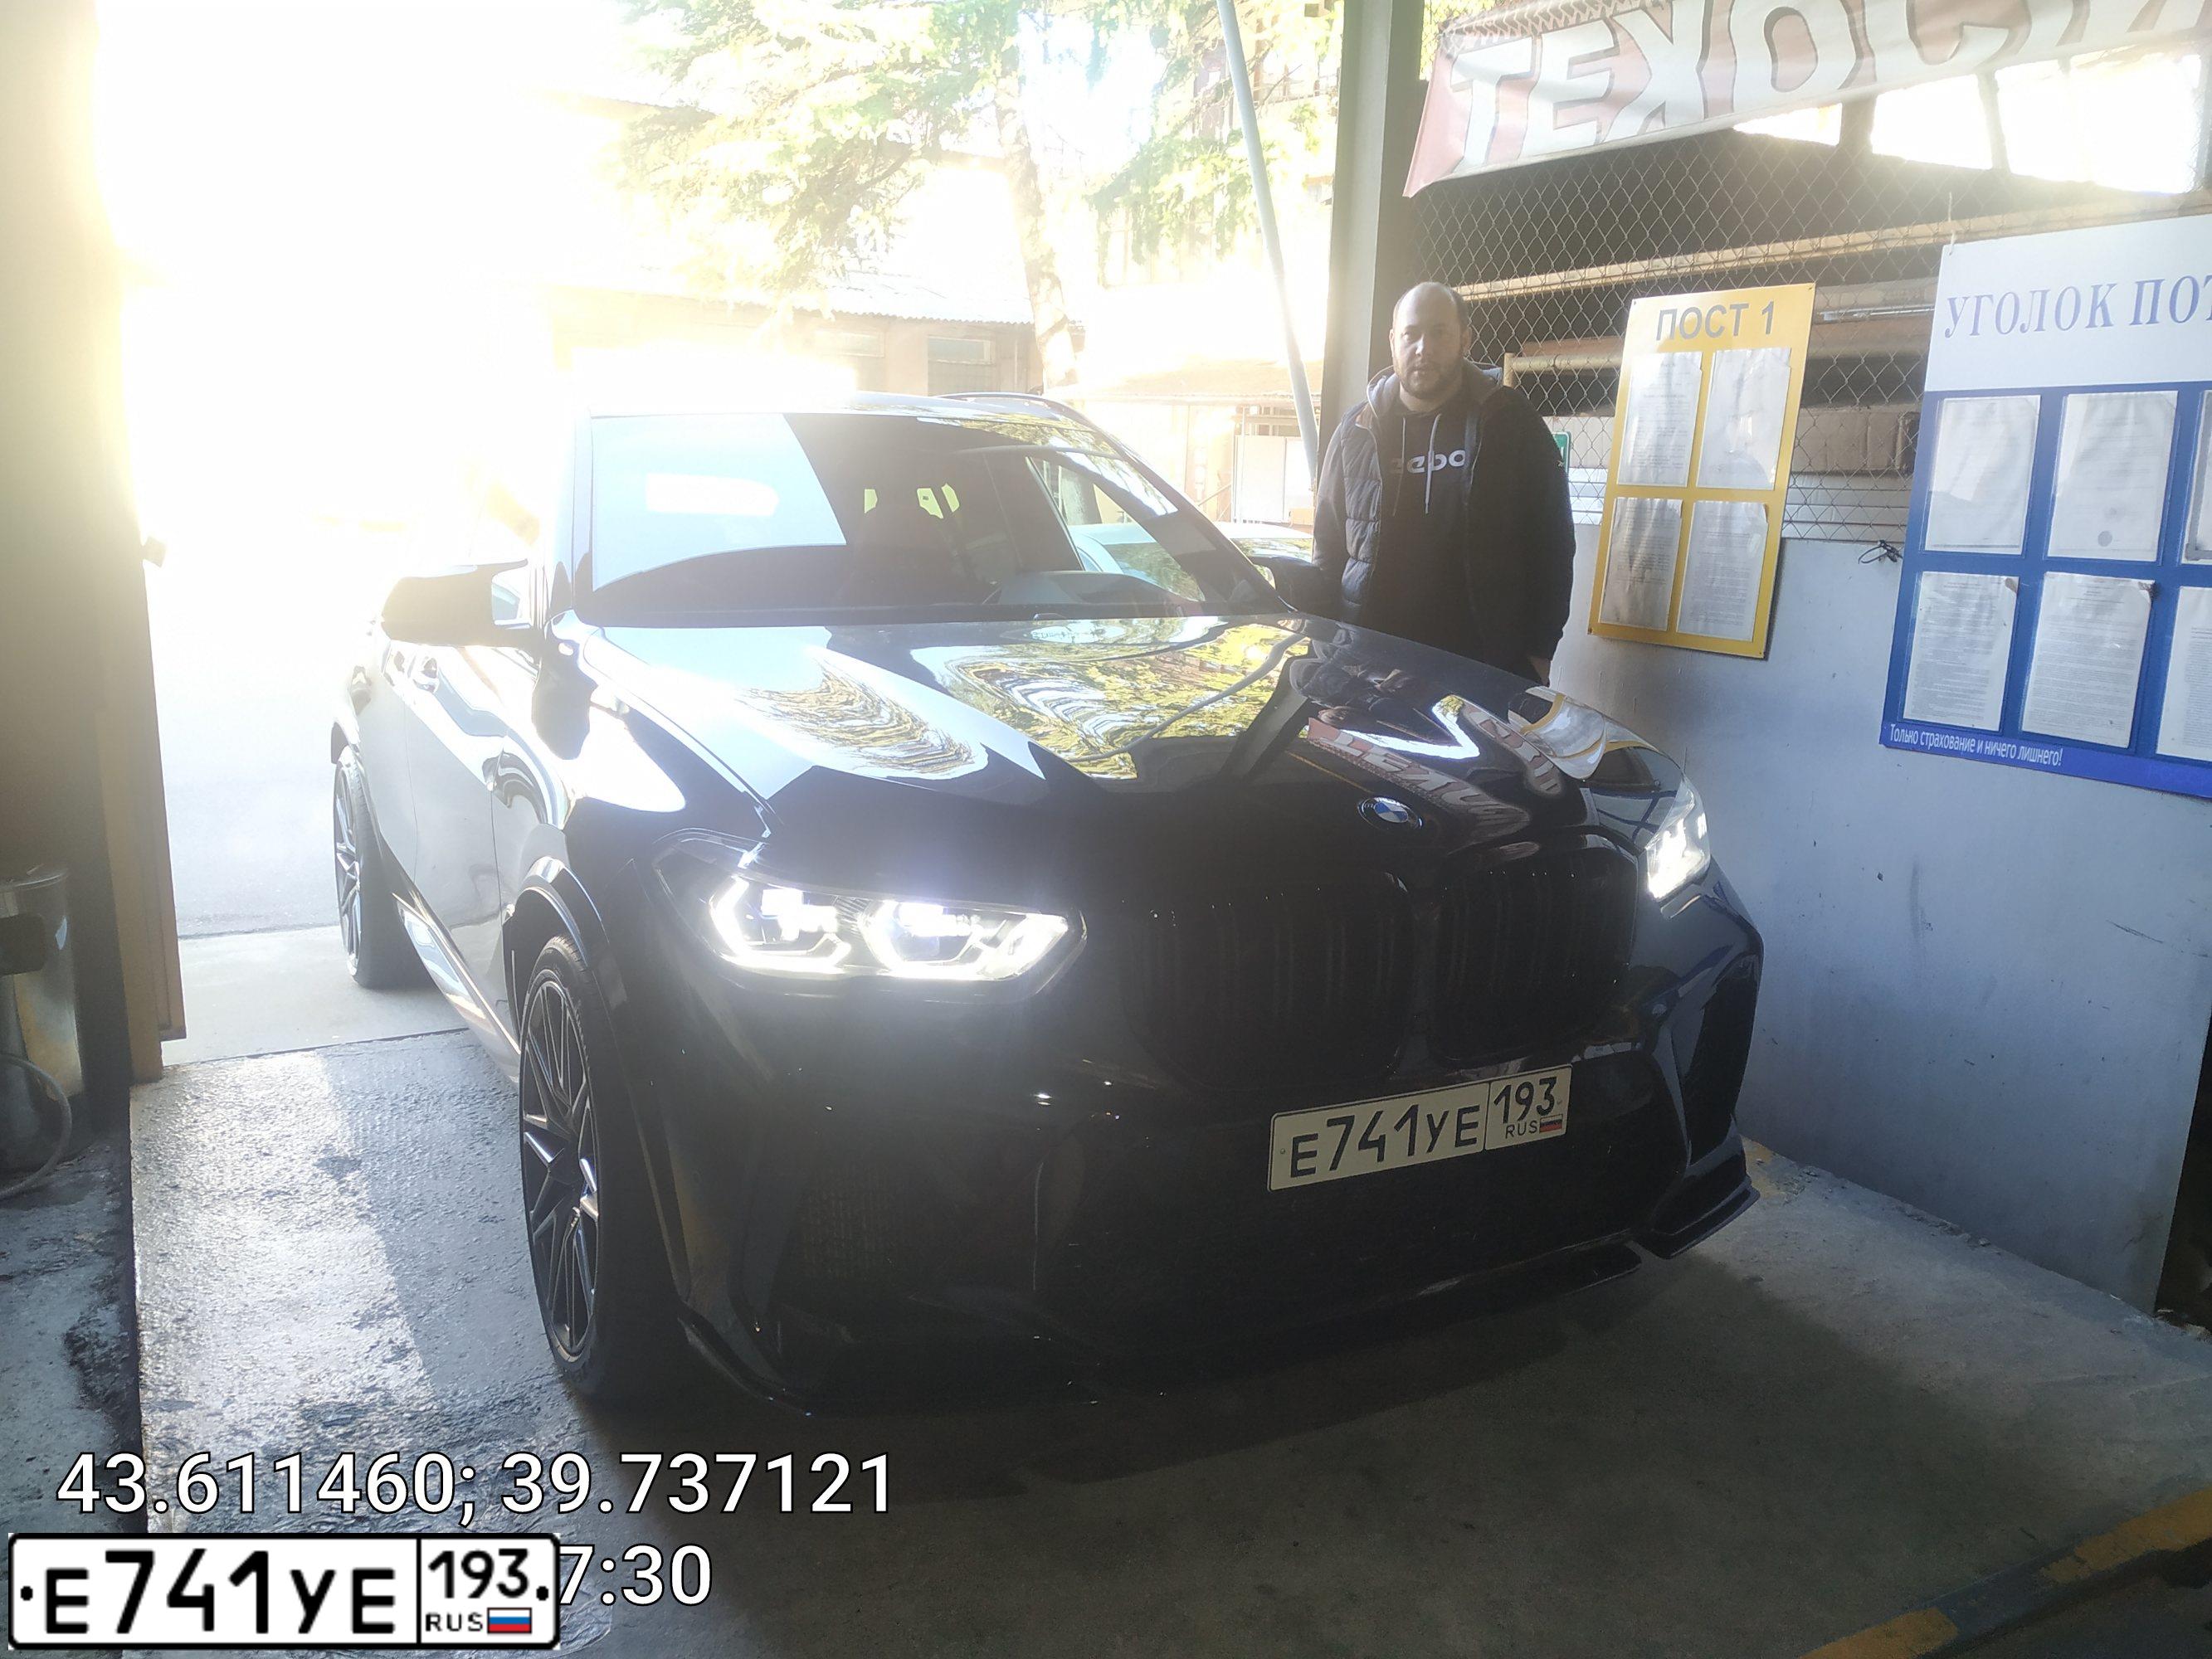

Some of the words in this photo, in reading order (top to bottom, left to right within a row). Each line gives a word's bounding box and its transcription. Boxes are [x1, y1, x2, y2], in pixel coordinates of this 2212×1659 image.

[1656, 304, 1749, 341] ПОСТ
[1761, 301, 1774, 334] 1
[1945, 283, 2117, 338] УГОЛОК
[1890, 723, 1918, 745] Только
[1920, 731, 1975, 753] страхование
[1976, 741, 1984, 754] и
[1985, 742, 2016, 758] ничего
[2018, 746, 2063, 766] лишнего!
[1290, 1104, 1479, 1179] Е741УЕ
[1493, 1077, 1557, 1124] 193
[1505, 1120, 1538, 1140] RUS
